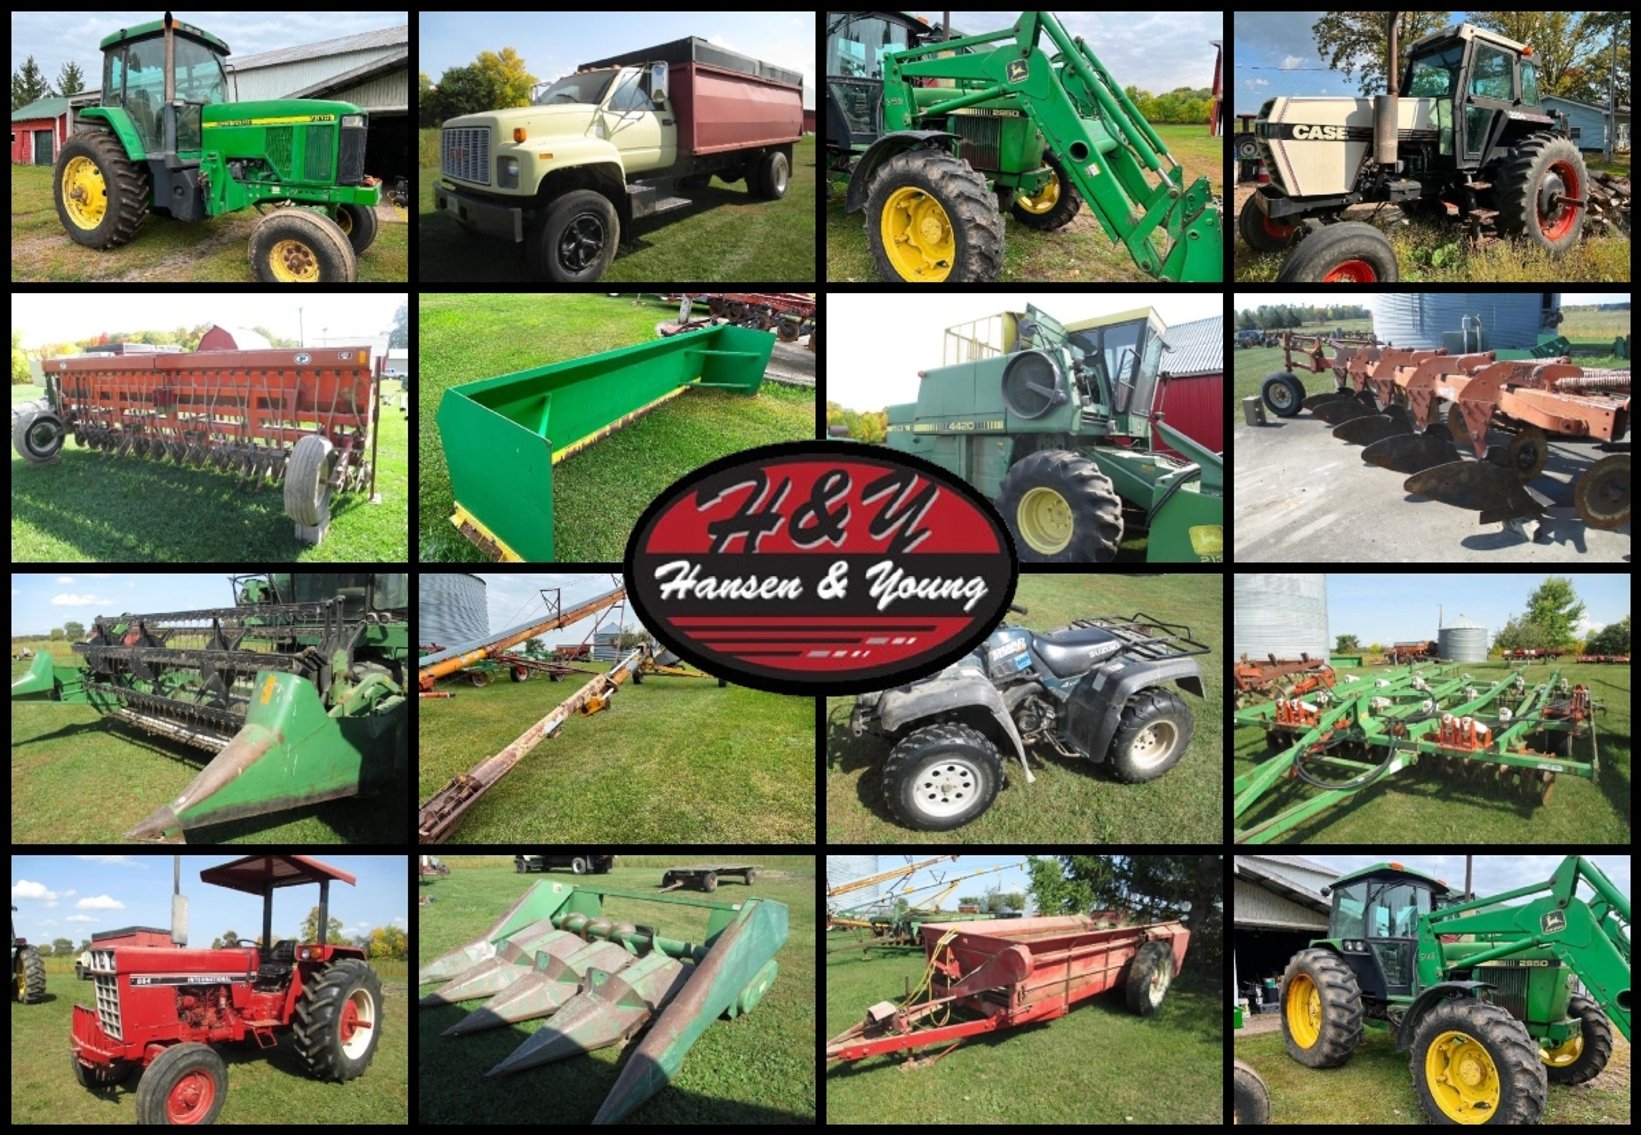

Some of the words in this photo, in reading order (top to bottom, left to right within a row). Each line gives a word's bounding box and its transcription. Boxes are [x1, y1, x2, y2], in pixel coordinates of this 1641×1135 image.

[1292, 124, 1349, 140] CASE
[948, 422, 975, 431] 4420
[1089, 641, 1120, 658] SUZUKI
